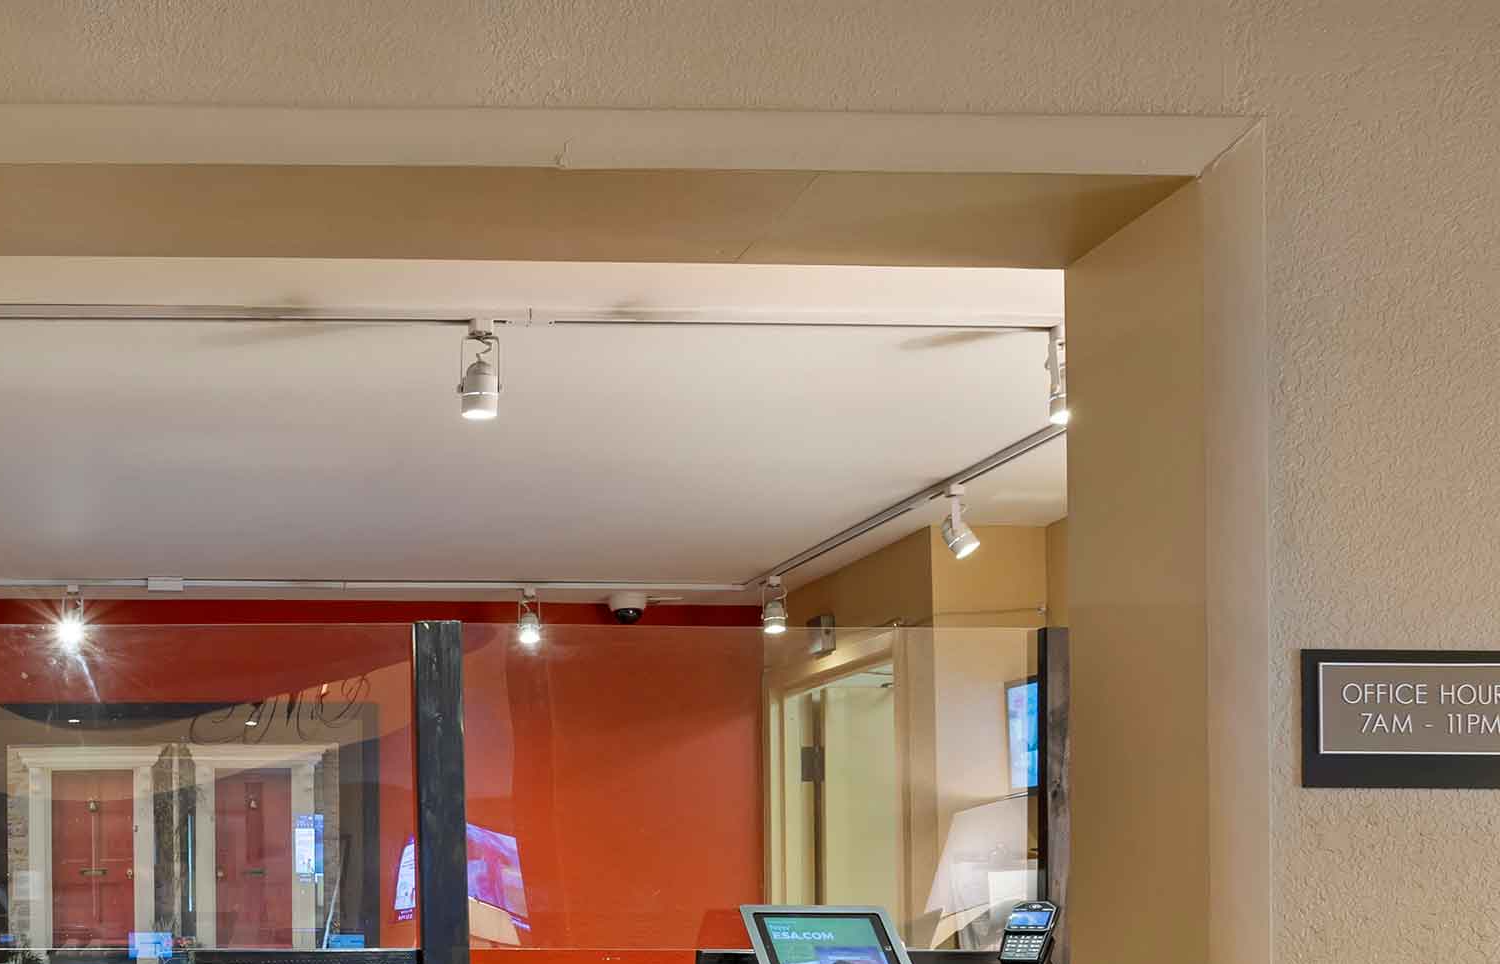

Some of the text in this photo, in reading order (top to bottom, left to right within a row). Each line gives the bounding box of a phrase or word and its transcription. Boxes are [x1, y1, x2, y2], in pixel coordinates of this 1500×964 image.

[1342, 683, 1428, 705] OFFICE
[1361, 713, 1413, 734] 7AM
[1447, 713, 1500, 734] 11PM
[772, 931, 835, 941] ESA.COM
